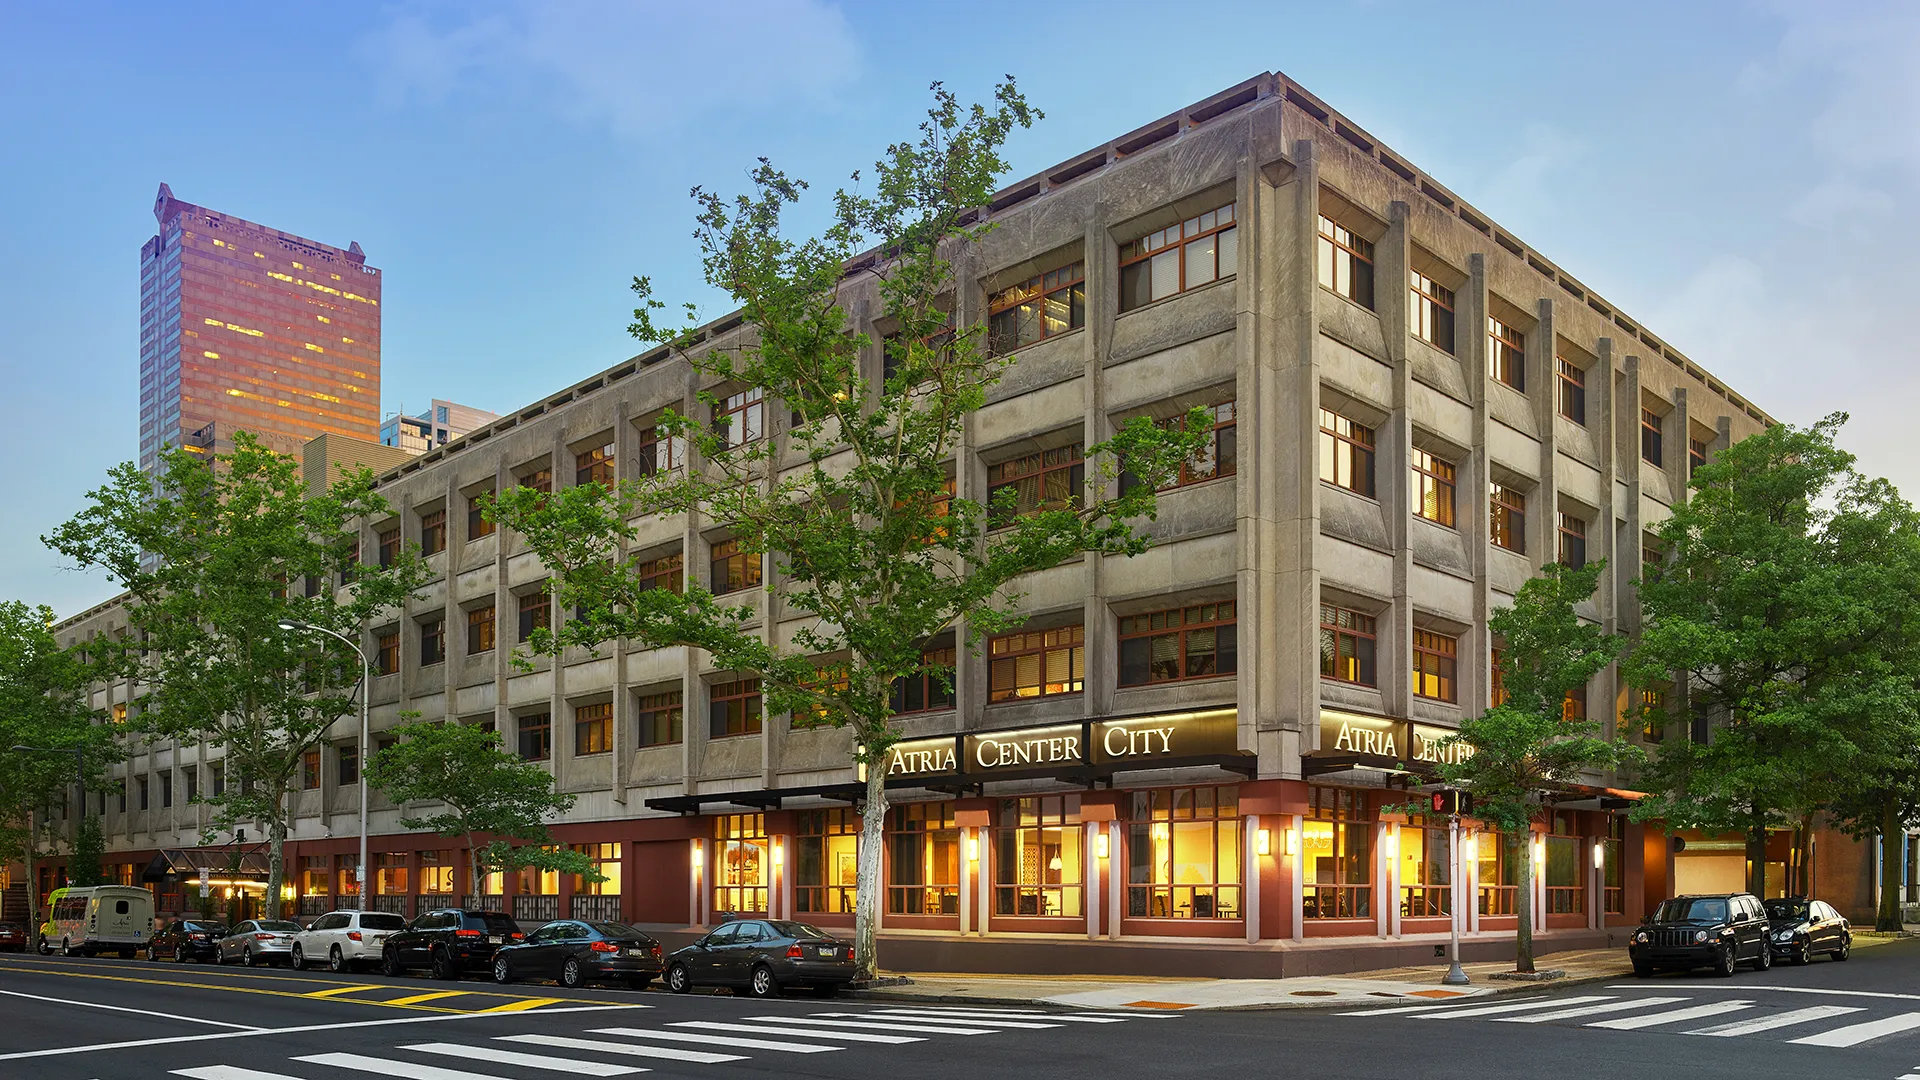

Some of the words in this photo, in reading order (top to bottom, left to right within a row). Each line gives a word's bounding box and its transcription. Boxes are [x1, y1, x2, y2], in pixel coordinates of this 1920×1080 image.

[888, 748, 957, 775] ATRIA
[977, 737, 1082, 767] CENTER
[1104, 726, 1175, 757] CITY
[1334, 720, 1398, 757] ATRIA
